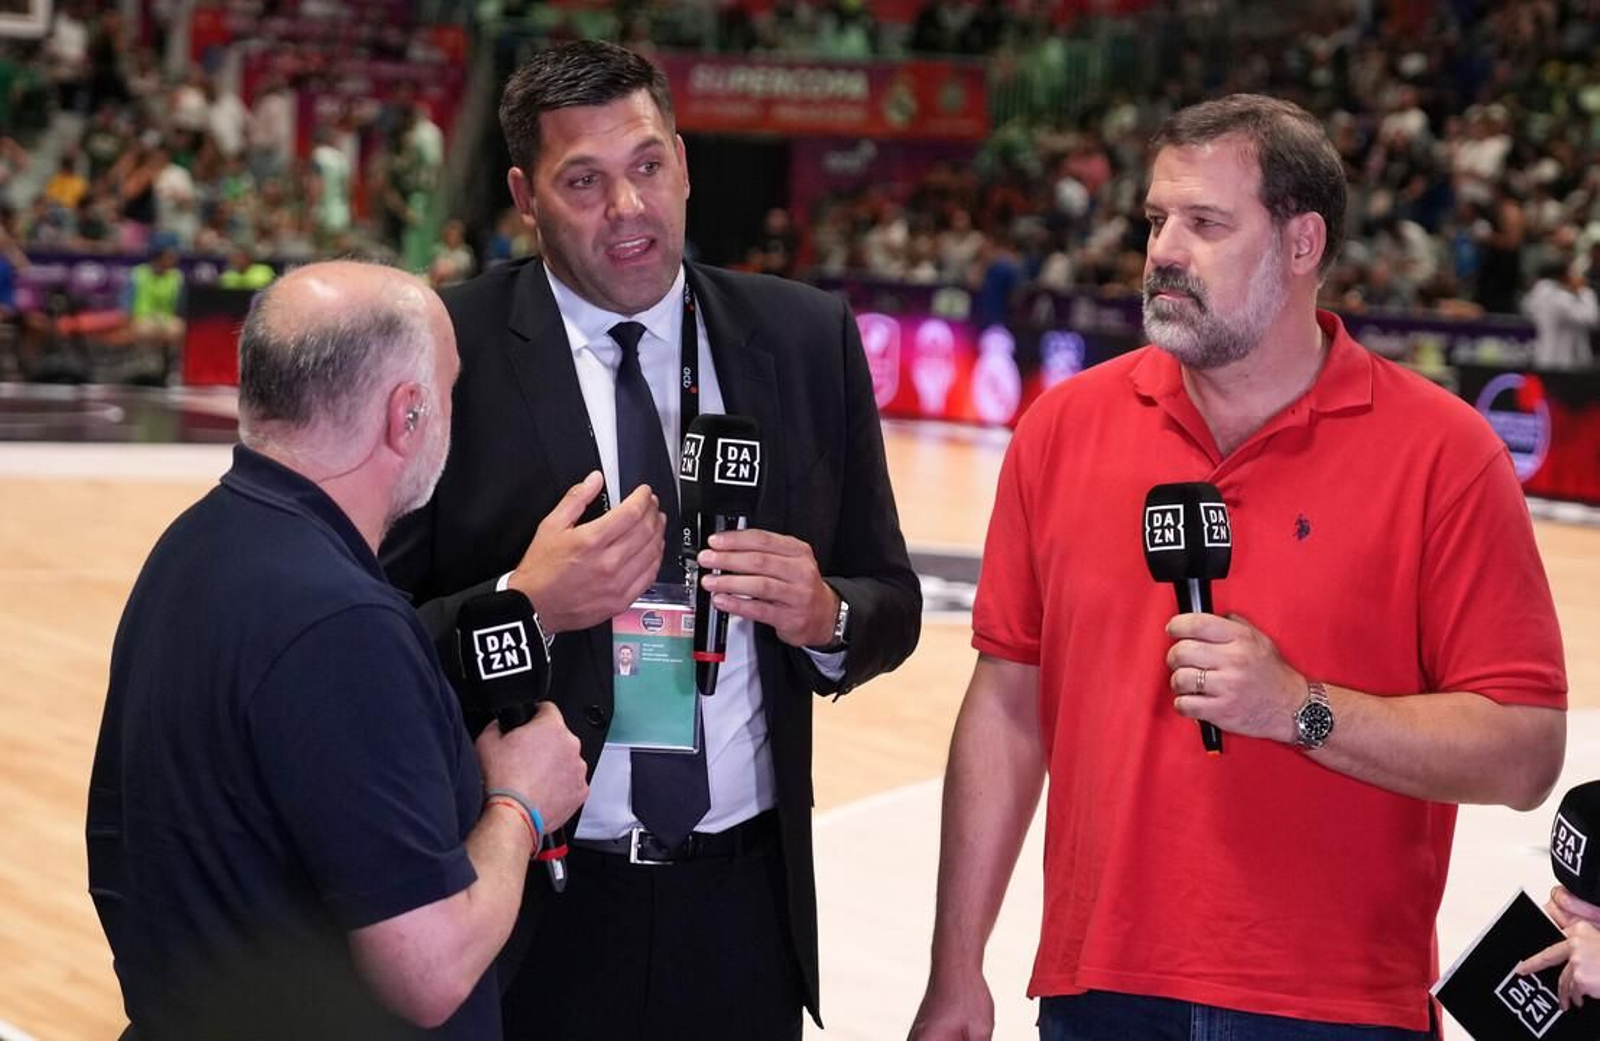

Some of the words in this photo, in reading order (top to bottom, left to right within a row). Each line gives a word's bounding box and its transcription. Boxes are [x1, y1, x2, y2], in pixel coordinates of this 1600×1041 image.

[683, 366, 693, 388] acb
[727, 446, 751, 462] DA
[726, 463, 750, 479] ZN
[1153, 512, 1175, 527] DA
[1209, 509, 1226, 524] DA
[1153, 528, 1175, 543] ZN
[1212, 525, 1227, 540] ZN
[486, 632, 516, 652] DA
[489, 649, 519, 670] ZN
[1558, 825, 1575, 851] DA
[1556, 840, 1573, 864] ZN
[1508, 978, 1535, 1006] DA
[1525, 994, 1552, 1023] ZN
